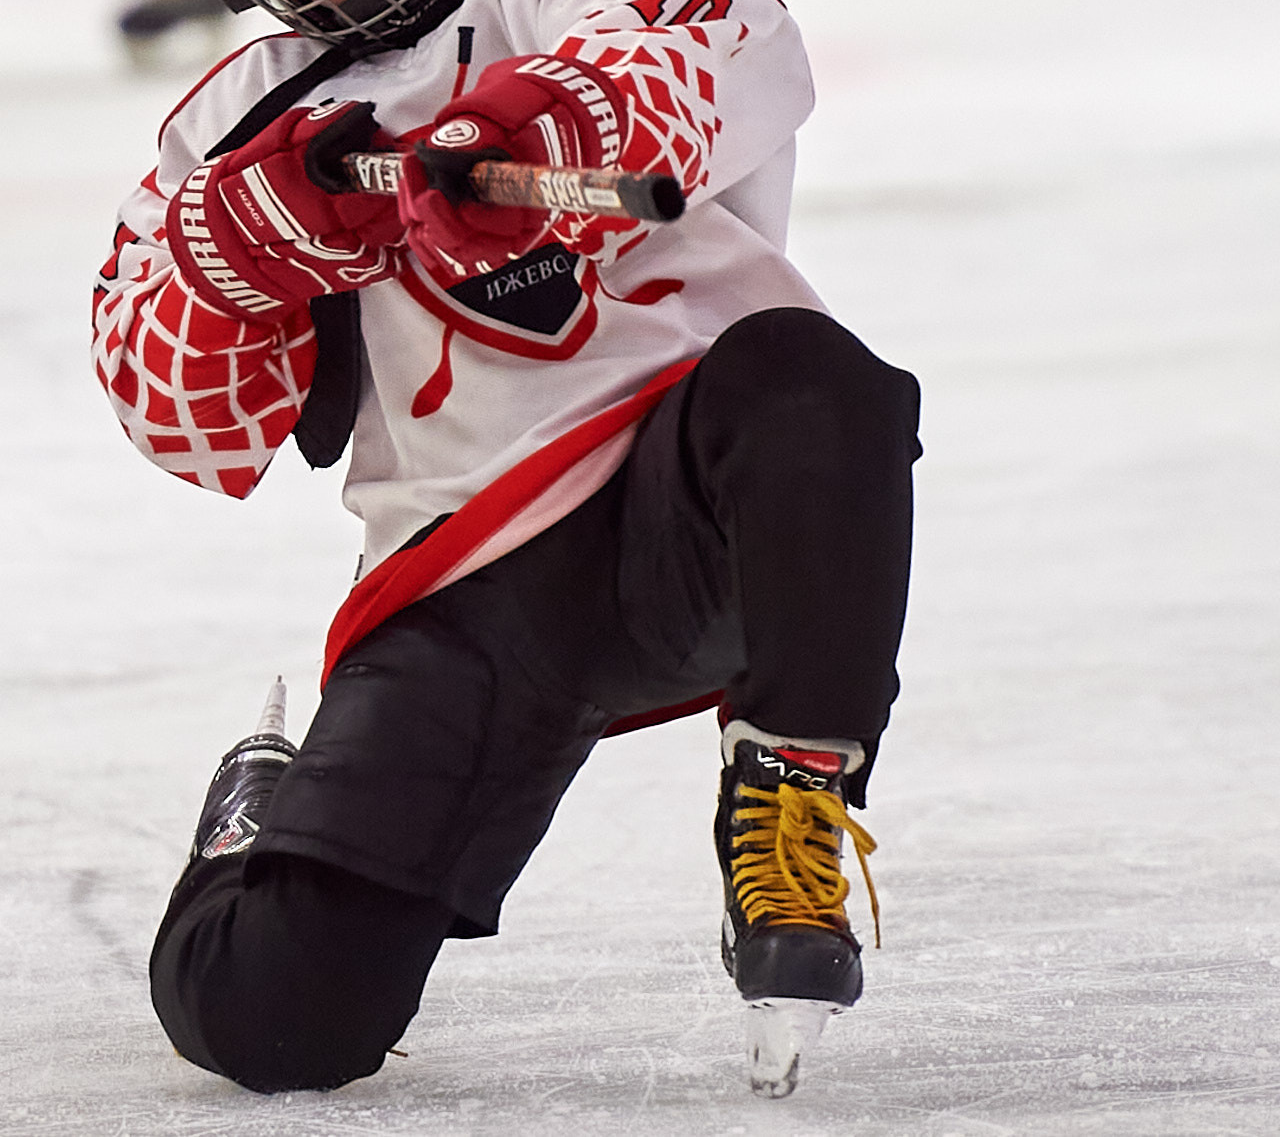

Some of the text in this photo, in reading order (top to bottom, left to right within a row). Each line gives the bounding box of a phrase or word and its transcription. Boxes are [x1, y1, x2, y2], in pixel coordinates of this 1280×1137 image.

[514, 57, 621, 168] WARR
[236, 187, 265, 227] COVERT
[485, 255, 572, 302] ИЖЕВС
